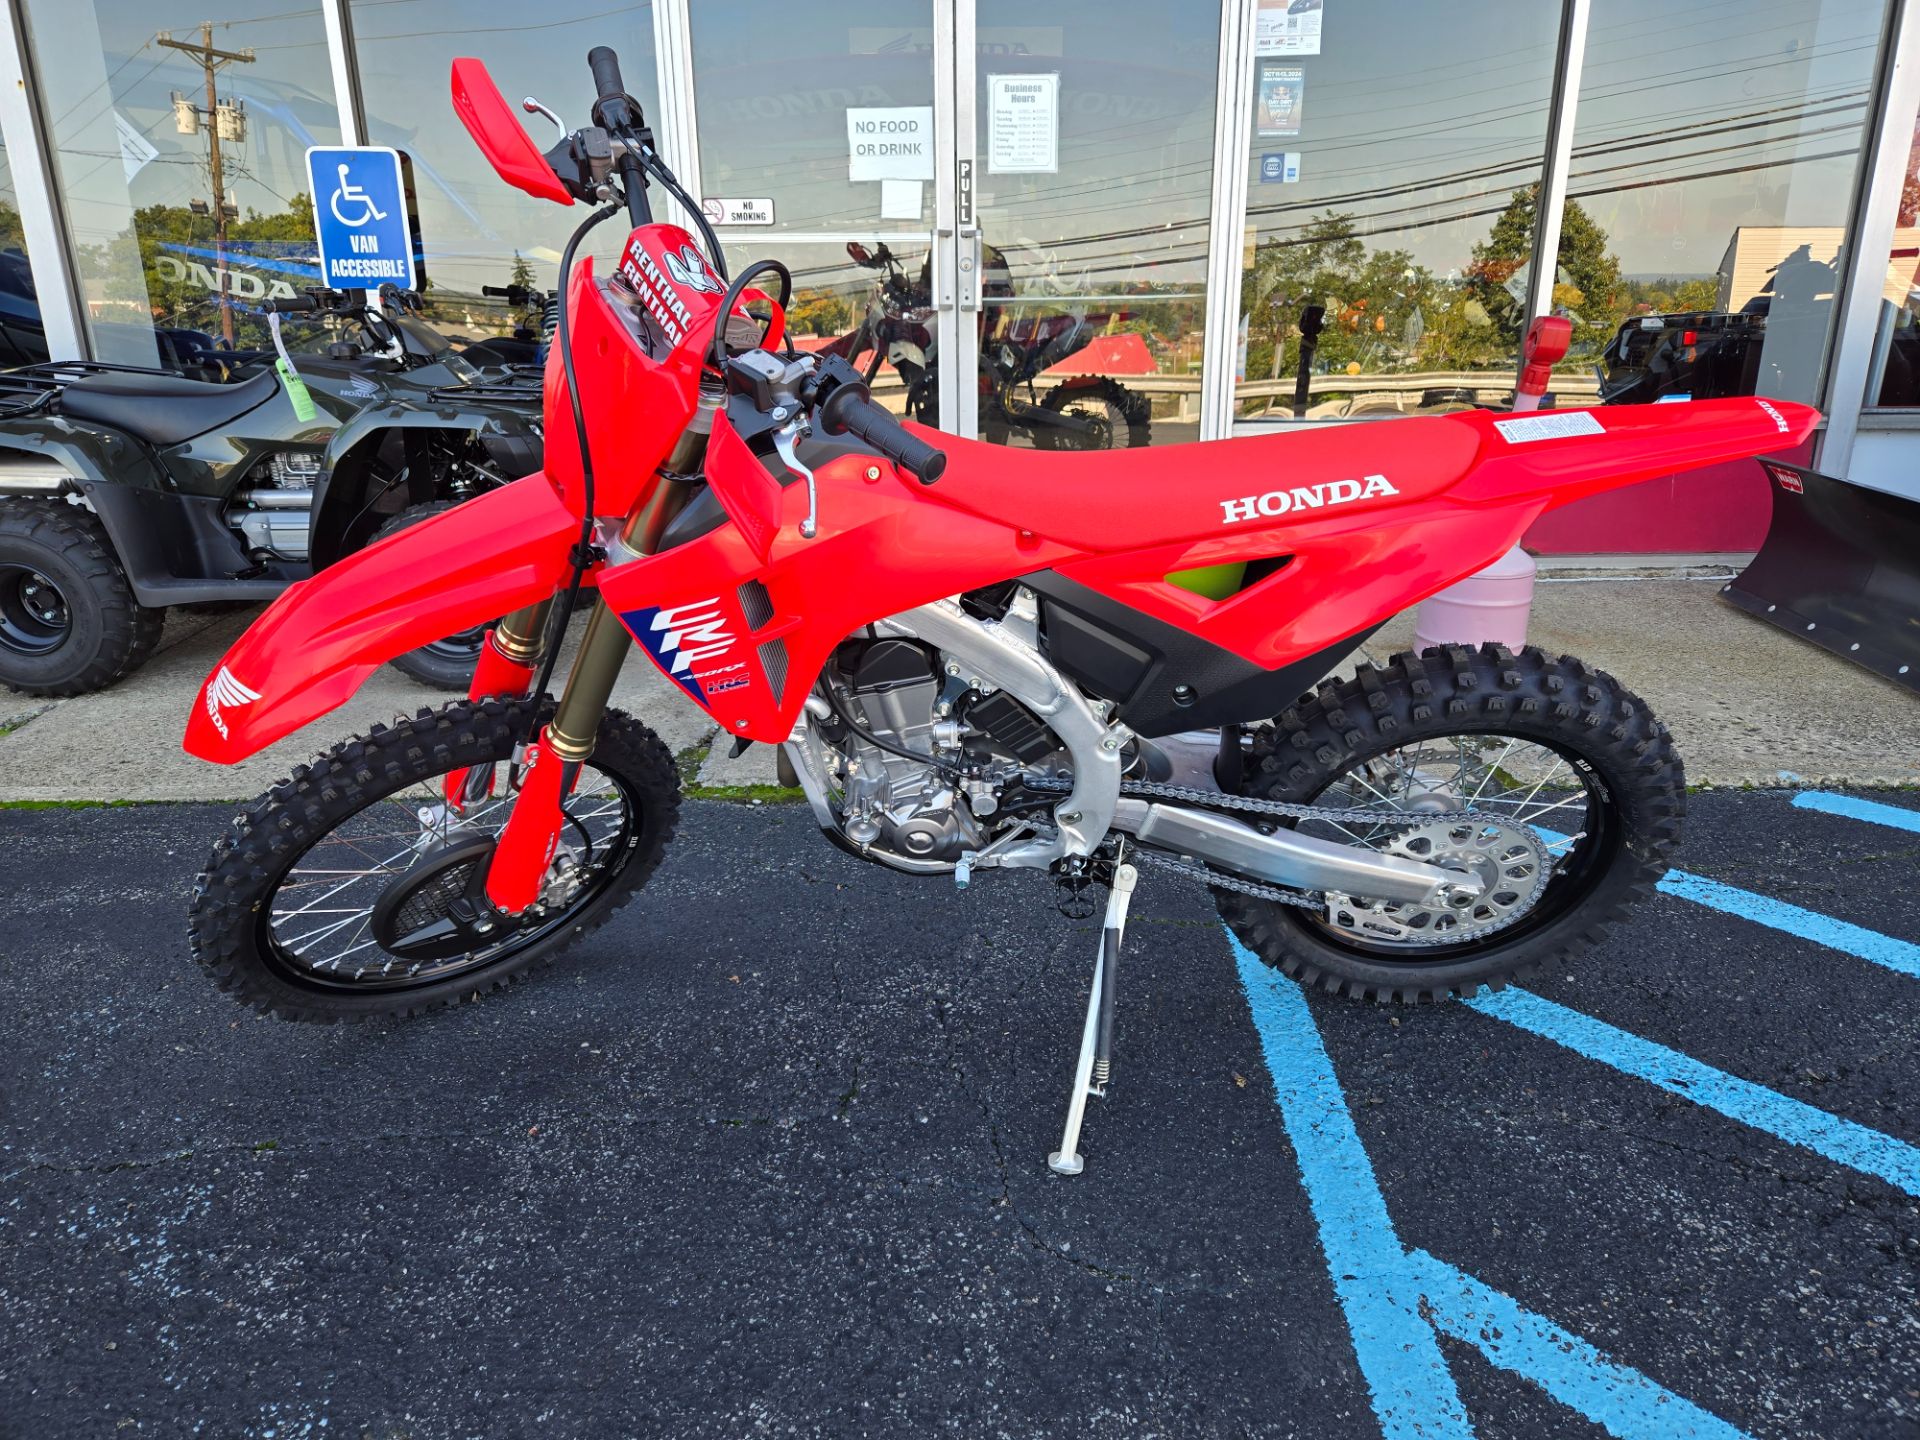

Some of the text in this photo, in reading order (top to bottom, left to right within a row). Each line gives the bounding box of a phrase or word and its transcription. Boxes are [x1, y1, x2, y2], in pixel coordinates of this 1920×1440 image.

[1004, 83, 1043, 93] Business
[1011, 94, 1036, 103] Hours
[855, 120, 919, 134] NO FOOD
[856, 143, 922, 156] OR DRINK
[961, 162, 970, 222] PULL
[742, 201, 754, 210] NO
[731, 212, 767, 221] SMOKING
[349, 235, 379, 253] VAN
[331, 258, 405, 277] ACCESSIBLE
[156, 256, 297, 299] ONDA
[630, 239, 693, 332] RENTHAL
[1755, 399, 1790, 433] HOND
[1220, 474, 1400, 524] HONDA
[679, 661, 747, 681] 450RX
[707, 672, 750, 695] HRC
[206, 681, 229, 741] HONDA
